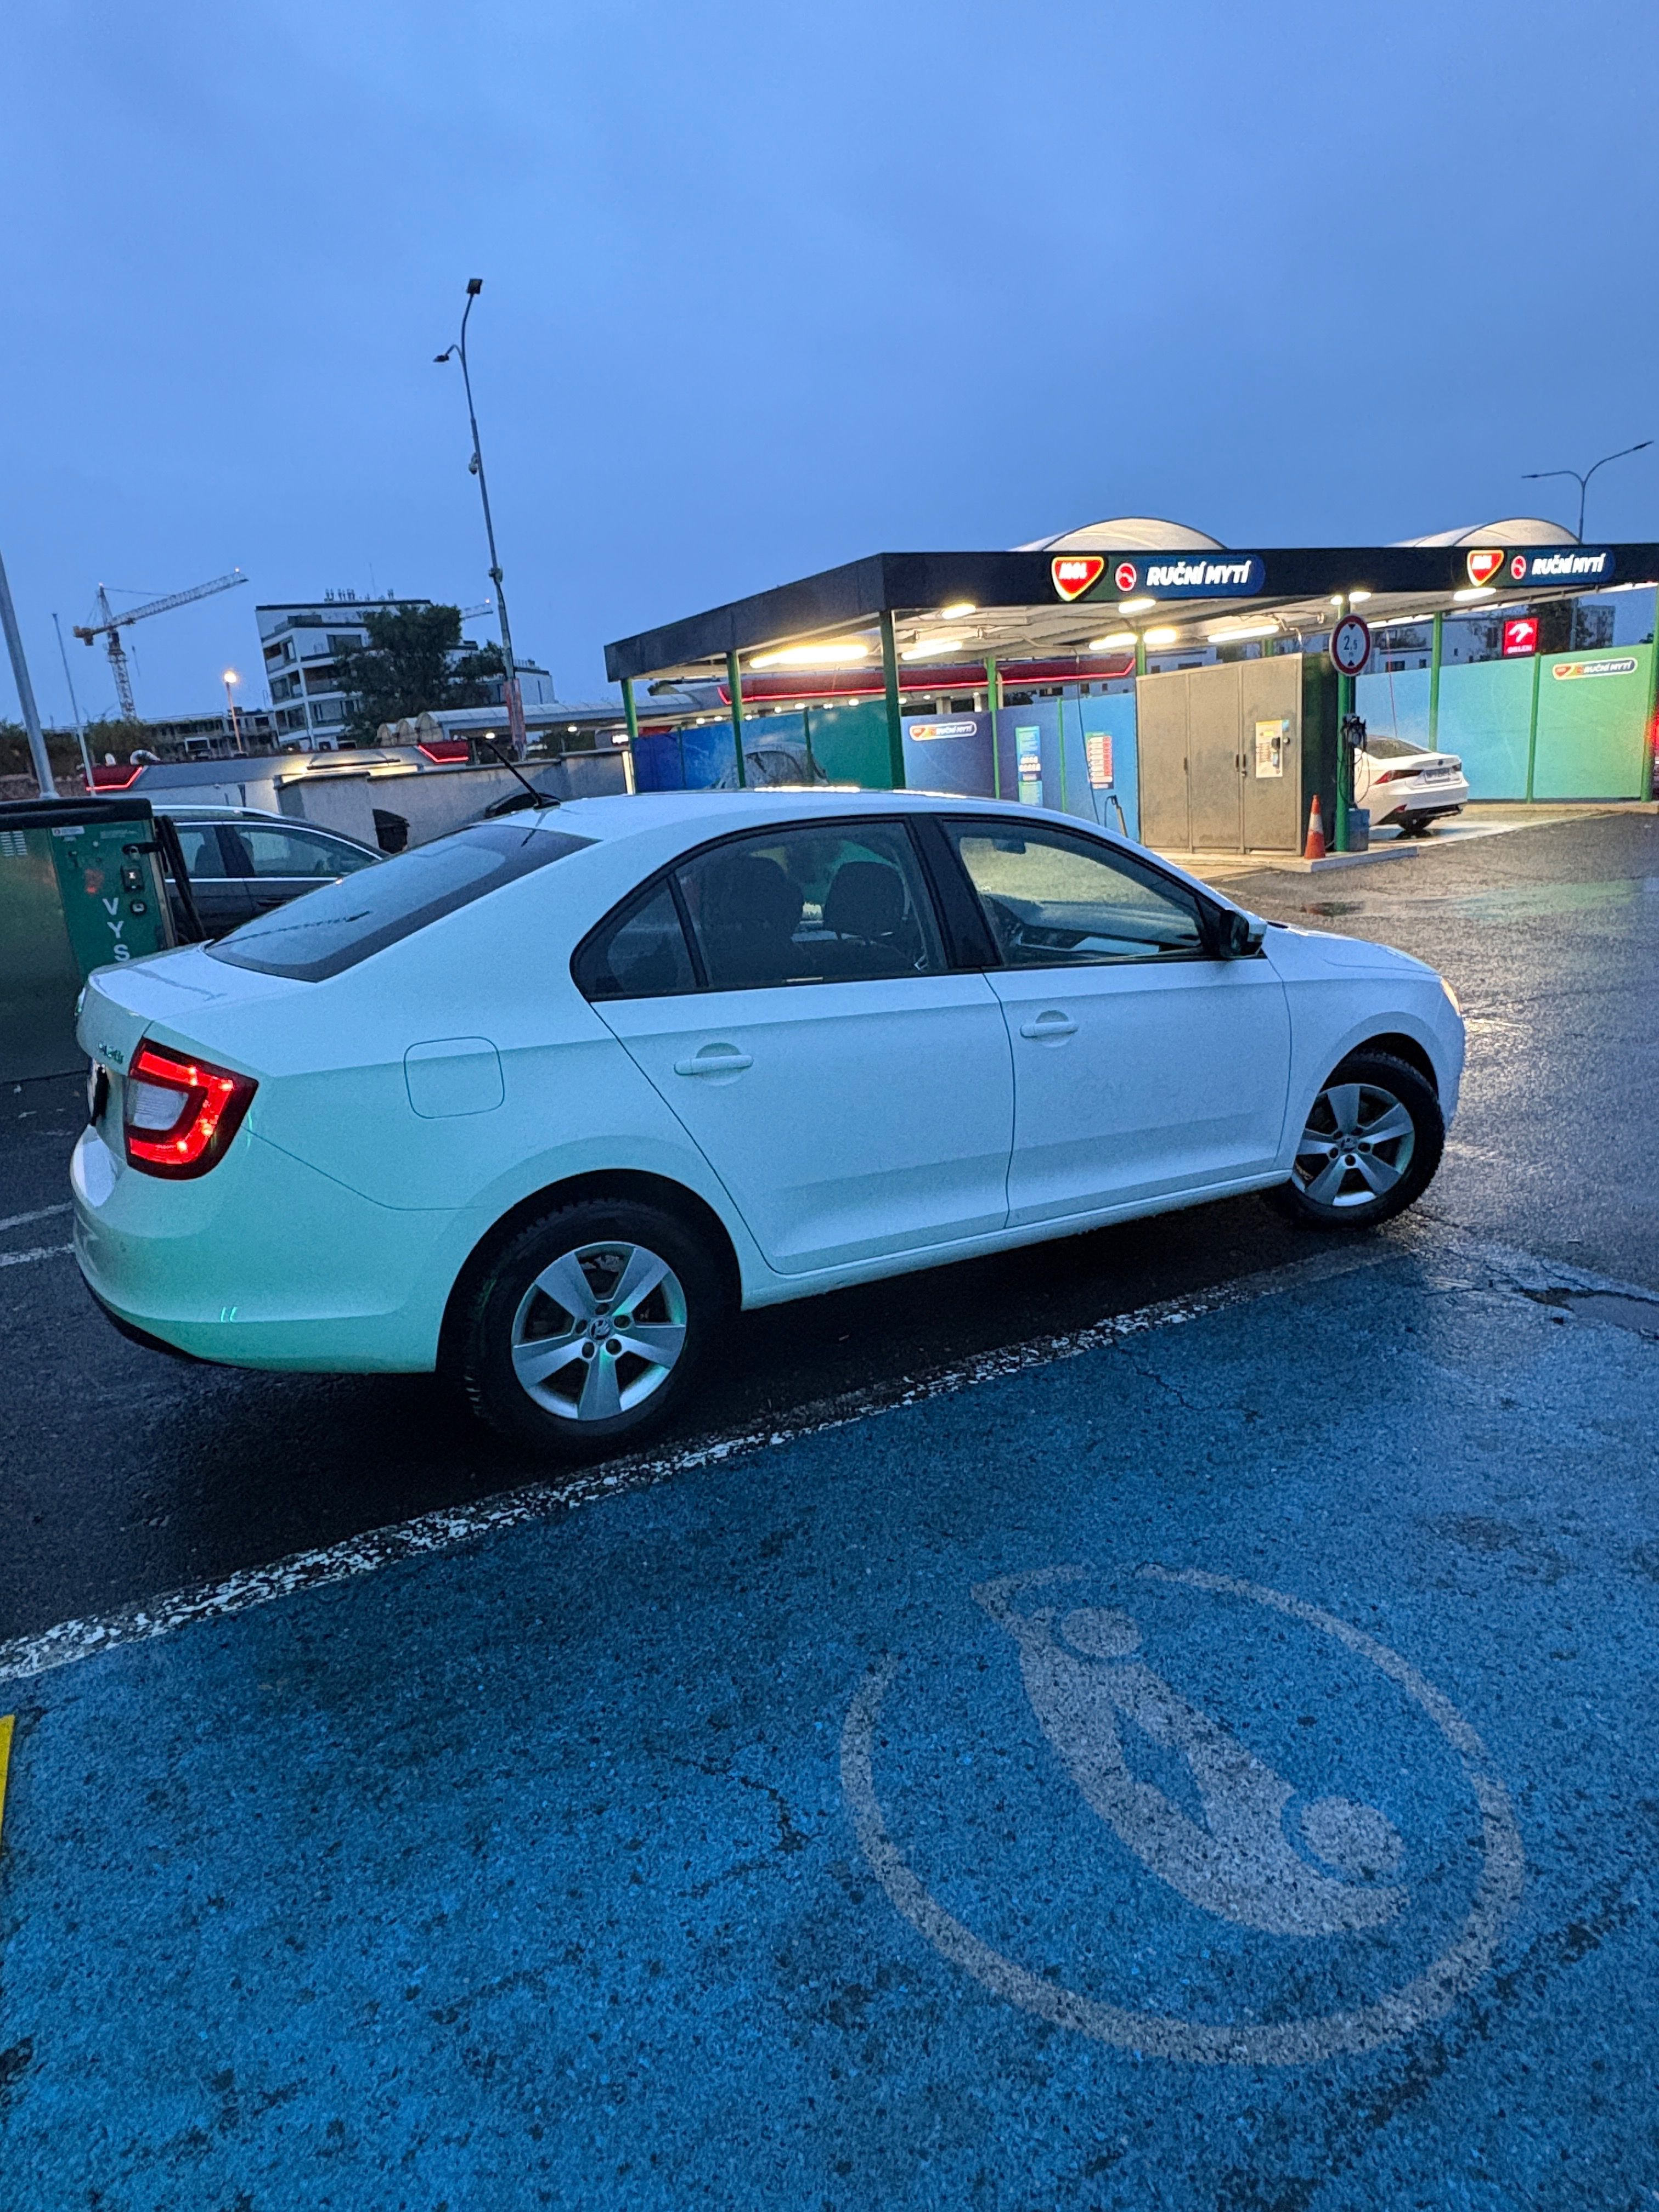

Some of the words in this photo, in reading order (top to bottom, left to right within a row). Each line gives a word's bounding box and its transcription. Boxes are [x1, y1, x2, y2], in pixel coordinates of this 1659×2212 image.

[1147, 561, 1206, 586] RUČNÍ
[1205, 560, 1252, 585] MYTÍ
[1532, 554, 1574, 575] RUČNÍ
[1572, 553, 1606, 573] MYTÍ
